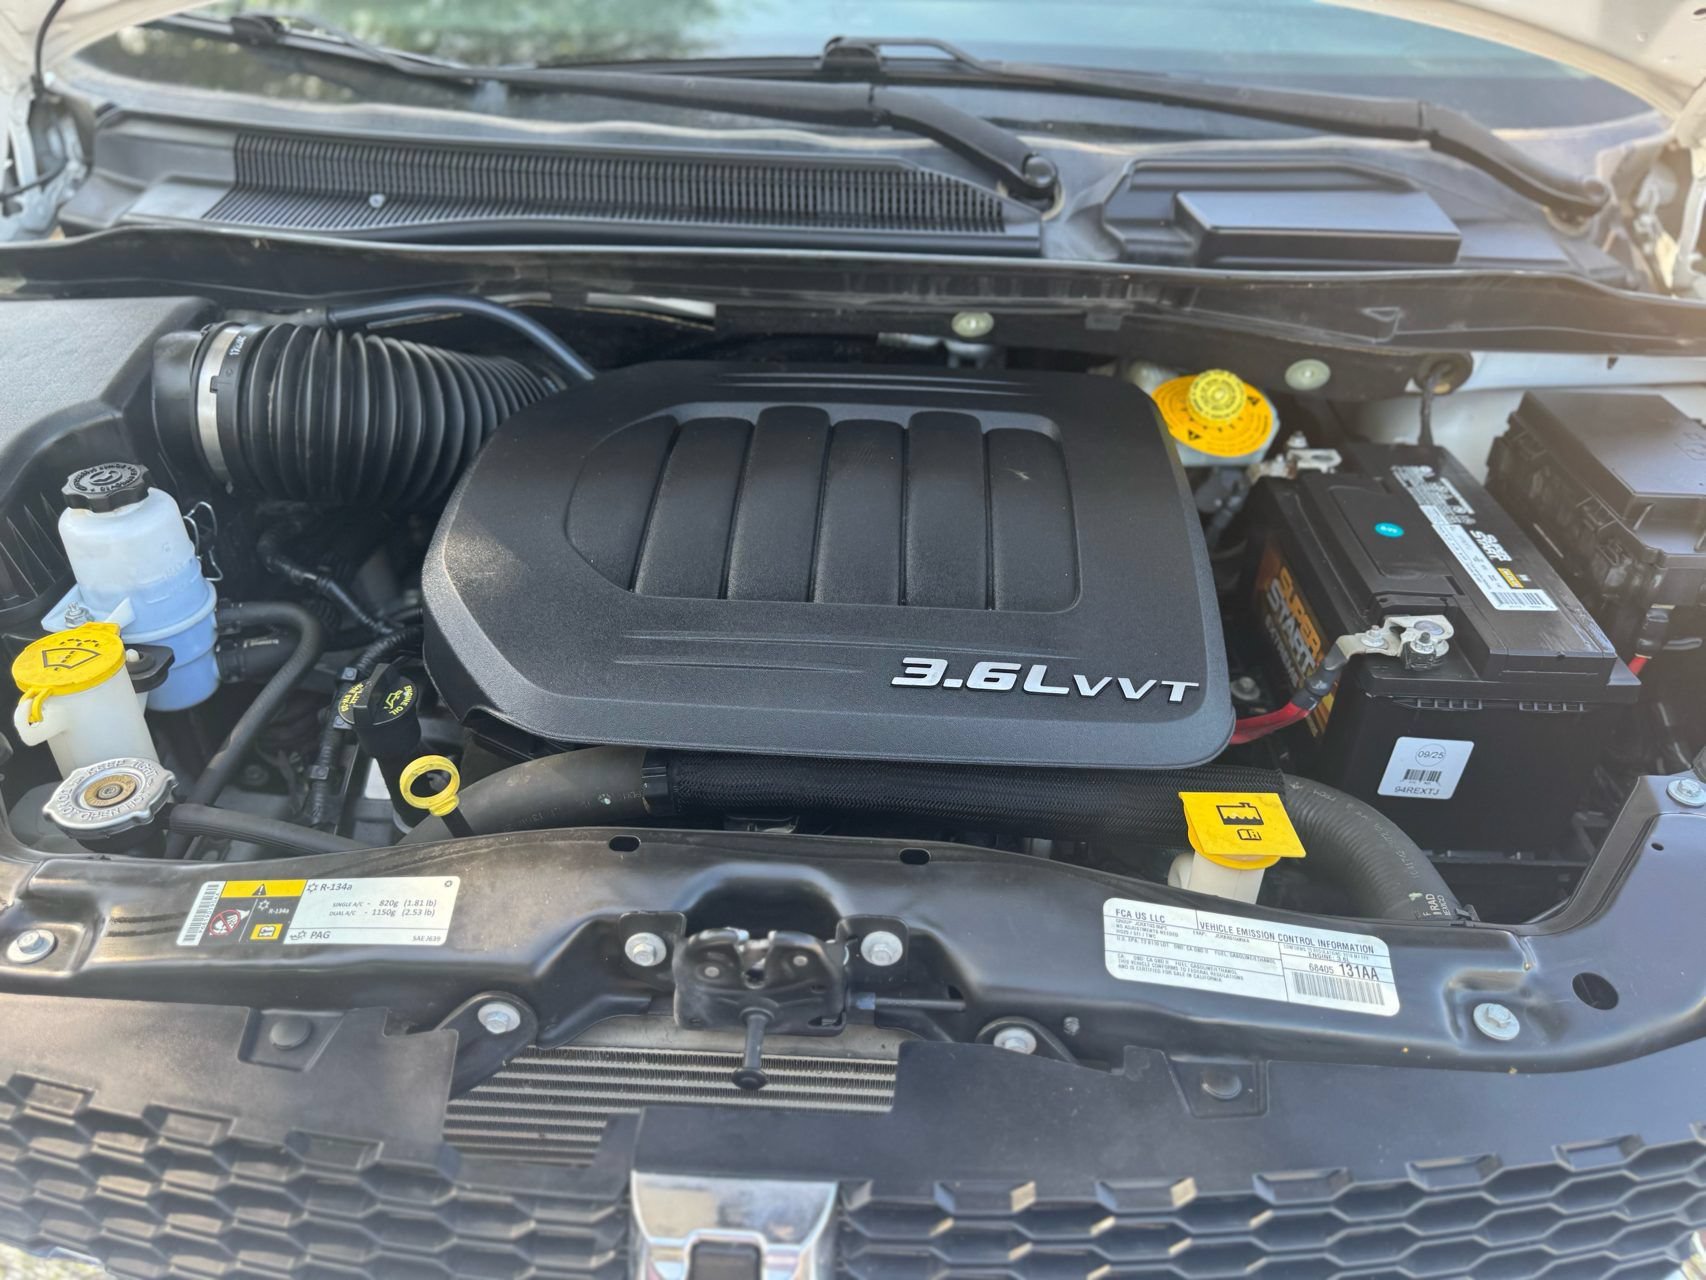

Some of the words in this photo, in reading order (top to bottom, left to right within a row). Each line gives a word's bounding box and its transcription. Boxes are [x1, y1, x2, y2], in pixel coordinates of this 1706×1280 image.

[1279, 565, 1321, 662] SUPER
[1266, 576, 1315, 673] START
[890, 656, 1070, 695] 3.6L
[1073, 673, 1200, 703] VVT
[400, 684, 413, 706] ENGINE
[388, 705, 404, 716] OIL
[1417, 750, 1444, 759] 09/25
[86, 760, 126, 776] KEEP
[1394, 786, 1440, 796] 94REXTJ
[320, 883, 352, 891] R-134a
[378, 900, 399, 908] 820g
[403, 900, 424, 908] (1.81
[426, 899, 437, 908] lb)
[372, 909, 396, 918] 1150g
[401, 909, 422, 917] (2.53
[424, 908, 436, 917] lb)
[1116, 908, 1132, 918] FCA
[1135, 911, 1147, 920] US
[1150, 914, 1166, 923] LLC
[310, 931, 331, 939] PAG
[1200, 922, 1233, 934] VEHICLE
[1236, 927, 1275, 940] EMISSION
[1277, 933, 1315, 946] CONTROL
[1317, 938, 1375, 954] INFORMATION
[1309, 963, 1334, 974] 68405
[1339, 963, 1380, 980] 131AA
